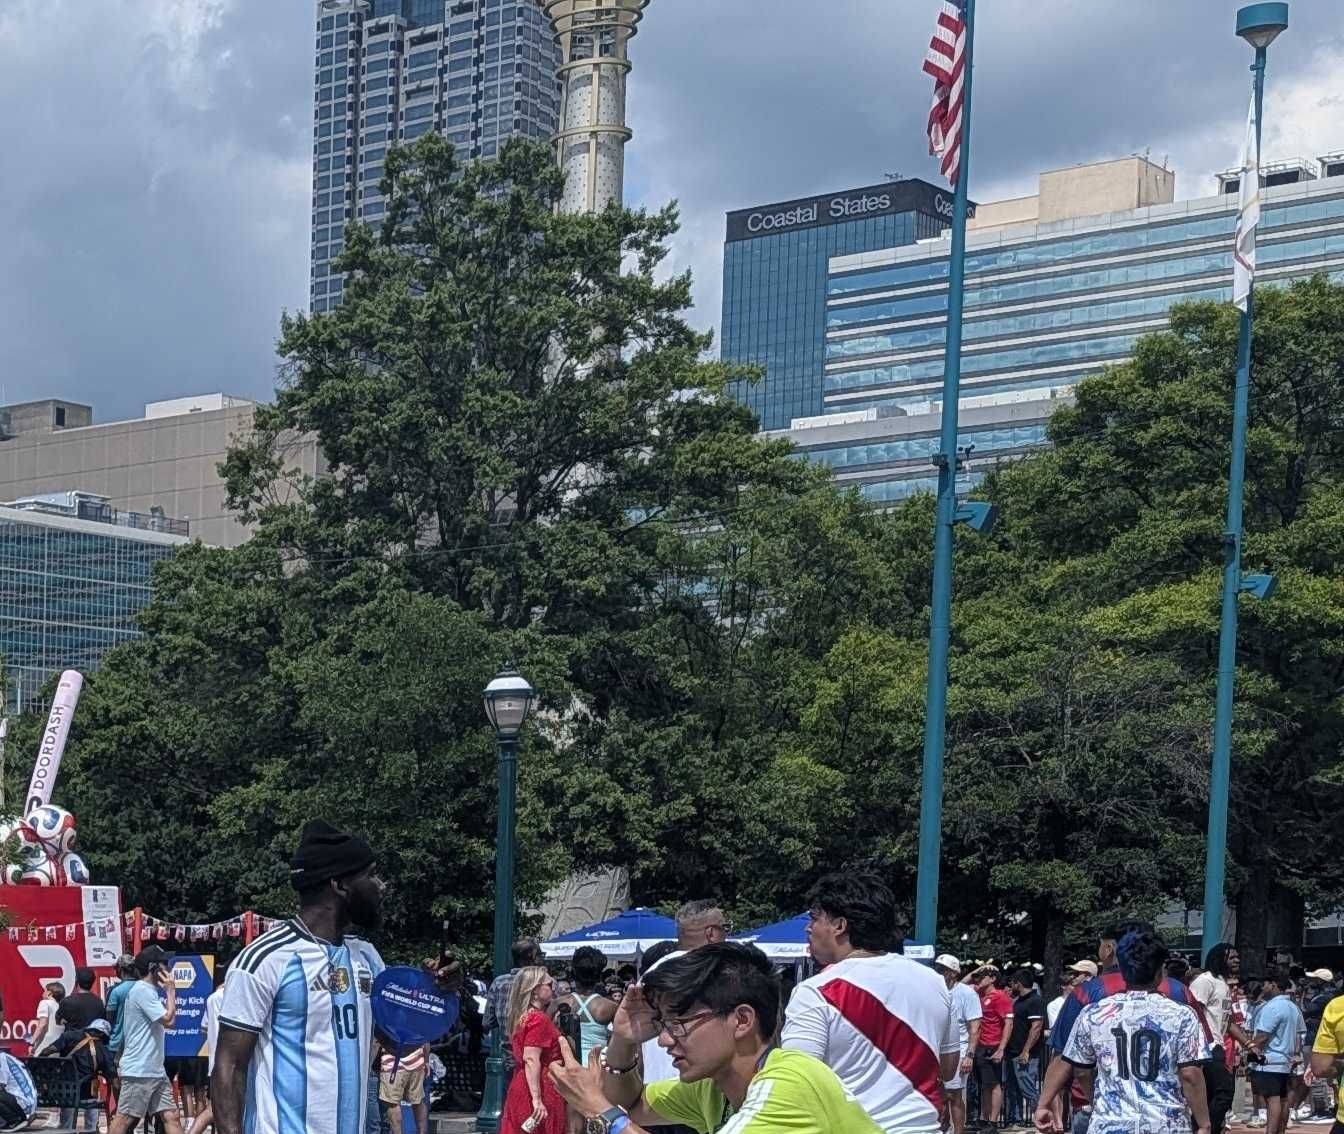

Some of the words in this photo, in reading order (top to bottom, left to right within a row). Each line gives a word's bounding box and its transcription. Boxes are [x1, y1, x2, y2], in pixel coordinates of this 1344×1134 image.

[747, 204, 817, 232] Coastal
[829, 193, 891, 217] States
[33, 706, 64, 790] DOORDASH
[173, 969, 192, 980] NAPA
[175, 1008, 200, 1017] allenge
[334, 1004, 358, 1040] 10
[1110, 1022, 1162, 1082] 10
